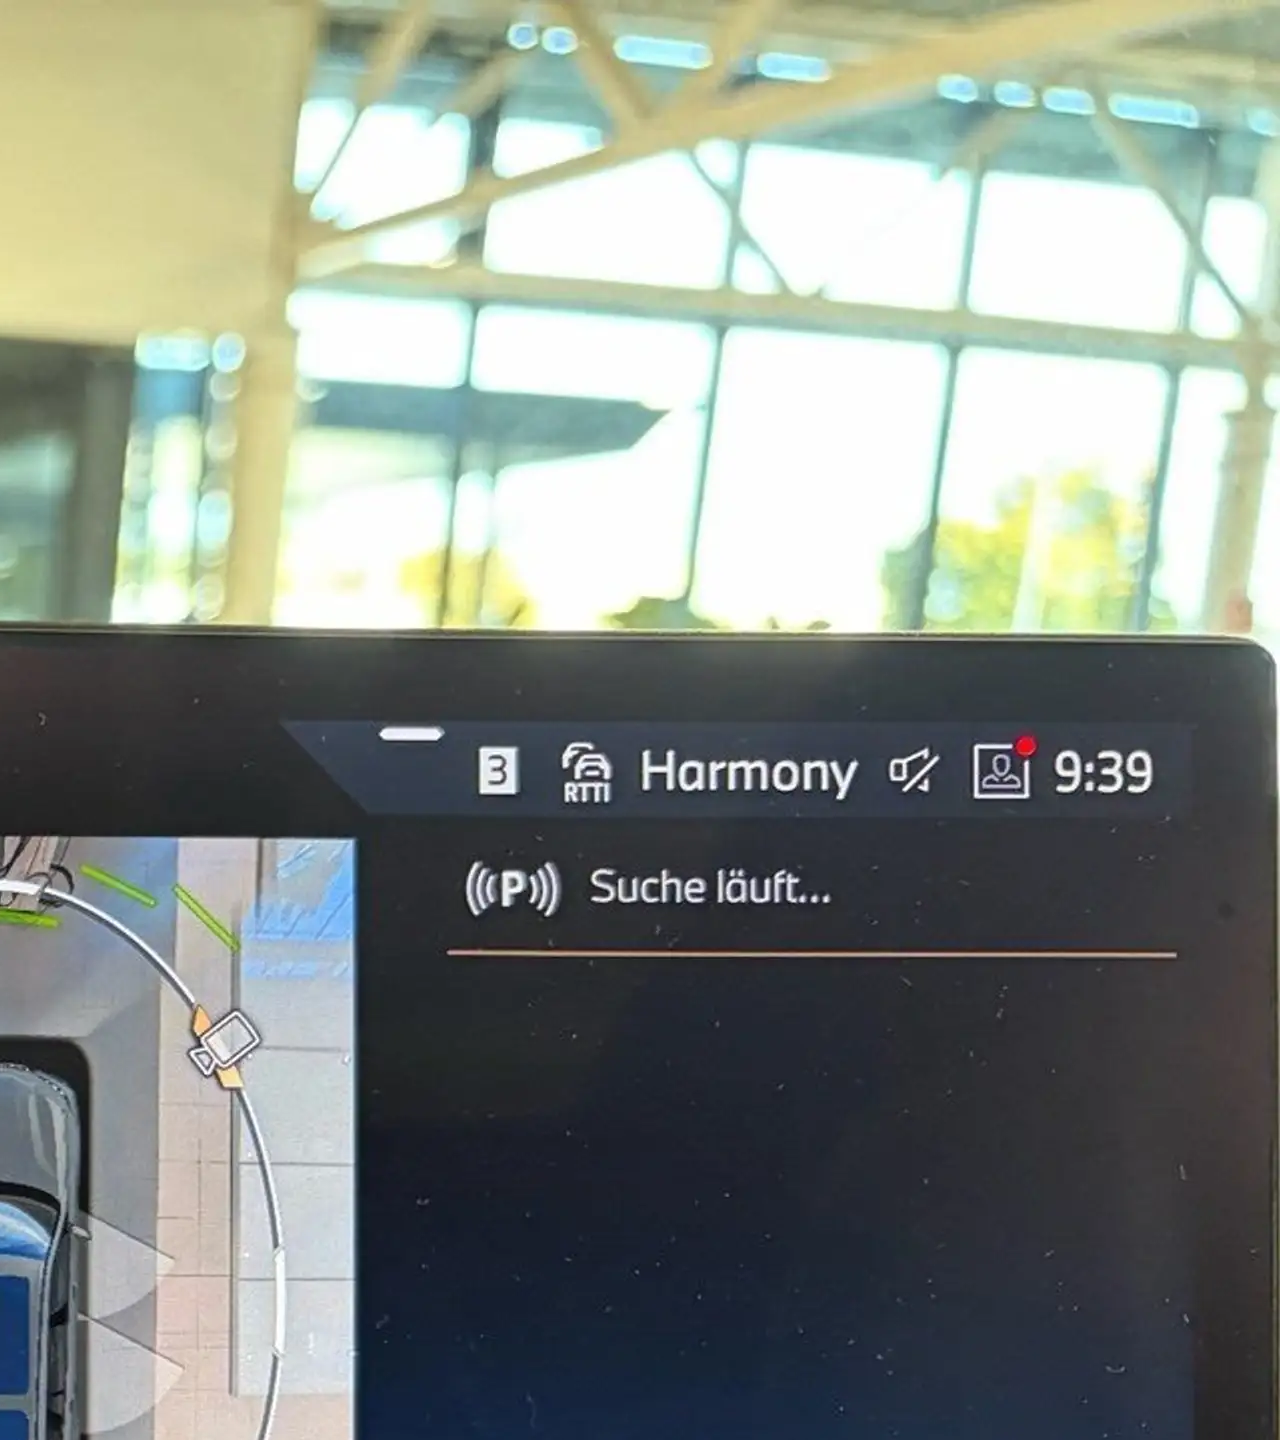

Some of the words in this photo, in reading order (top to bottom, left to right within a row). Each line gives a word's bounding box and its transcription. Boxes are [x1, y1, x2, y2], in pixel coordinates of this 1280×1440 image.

[641, 749, 859, 801] Harmony
[1054, 749, 1153, 794] 9:39
[564, 781, 611, 803] RTTI
[590, 868, 707, 904] Suche
[717, 868, 831, 904] läuft...
